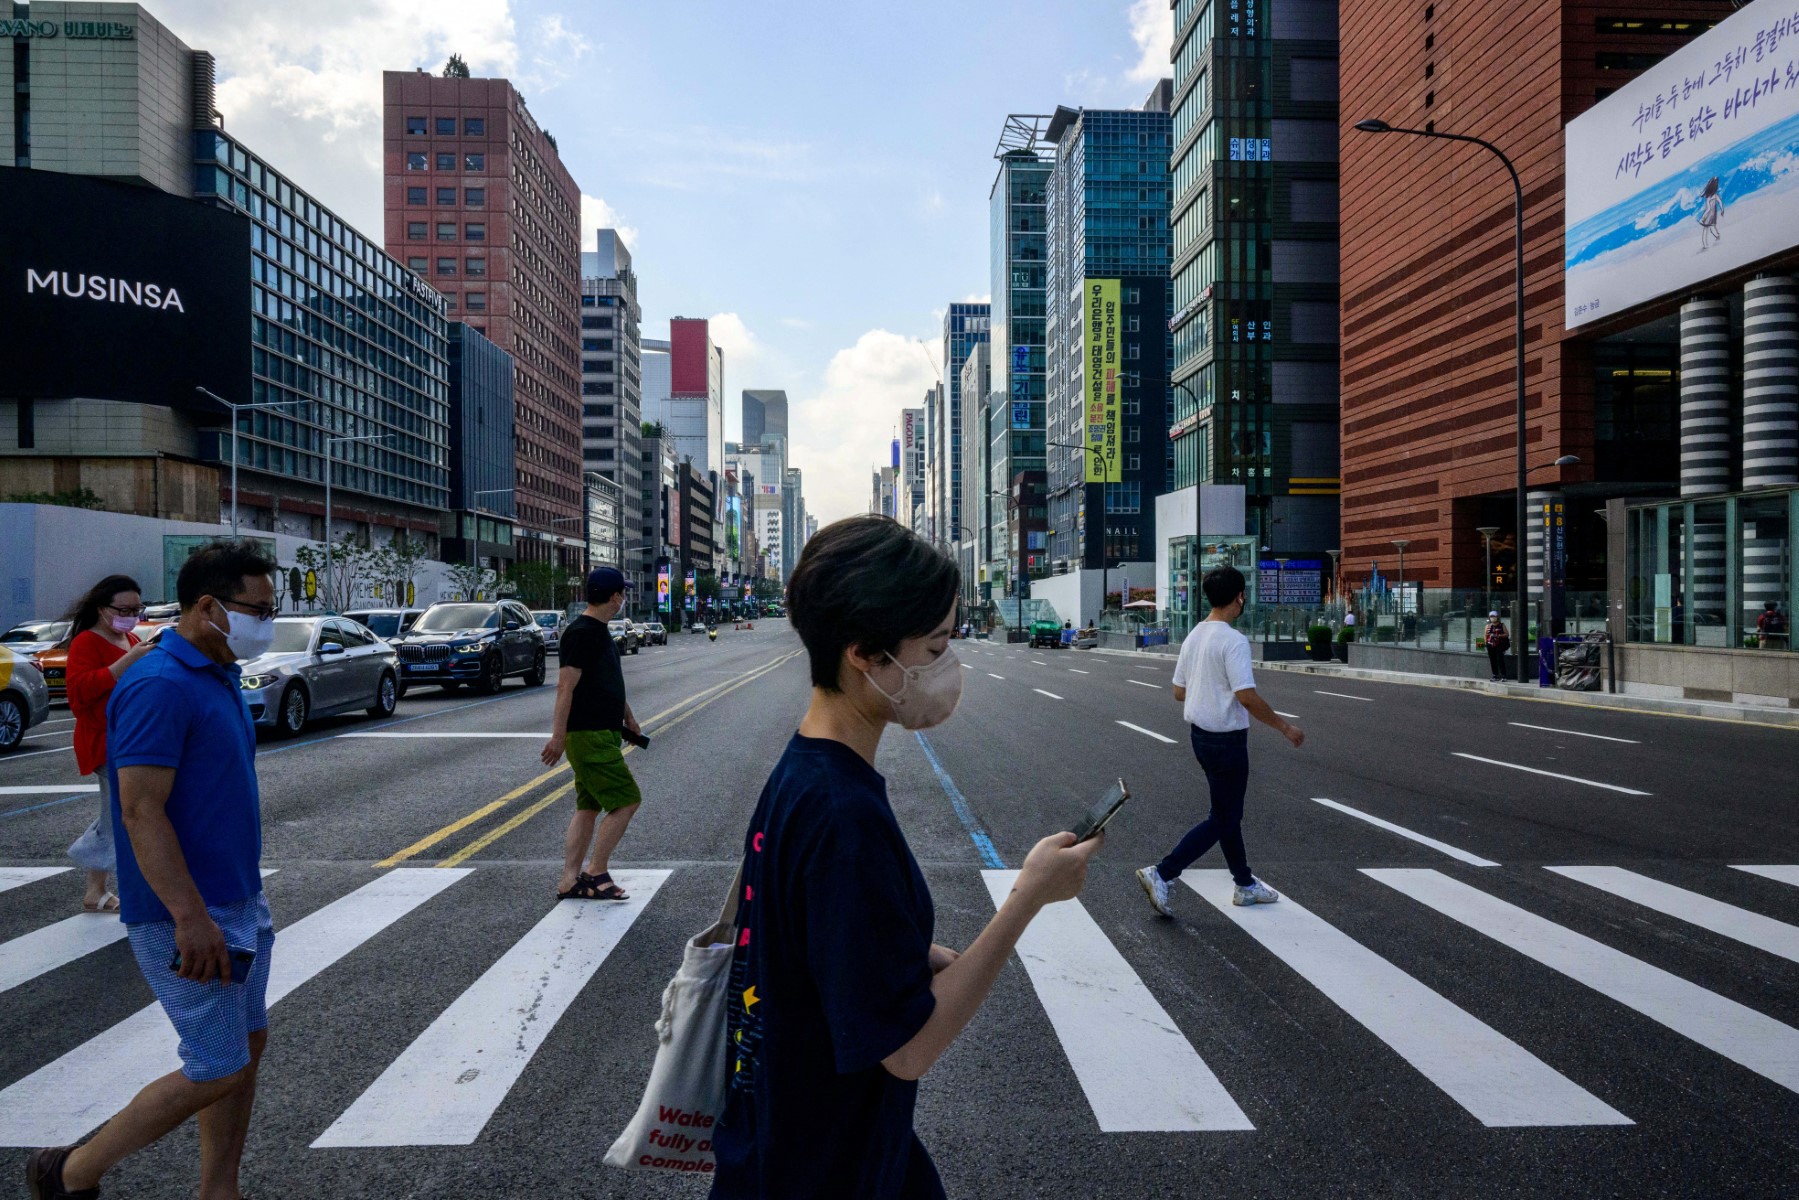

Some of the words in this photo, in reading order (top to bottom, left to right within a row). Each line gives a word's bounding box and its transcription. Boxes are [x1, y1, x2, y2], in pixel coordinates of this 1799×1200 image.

[64, 21, 132, 39] 비제바노
[1632, 94, 1664, 134] 우리들
[1666, 84, 1679, 109] 두
[1682, 69, 1705, 101] 눈에
[1708, 45, 1747, 86] 그득히
[1615, 141, 1654, 180] 시작도
[1657, 123, 1684, 159] 끝도
[1689, 105, 1717, 142] 없는
[1724, 66, 1780, 120] 바다가
[26, 267, 186, 314] MUSINSA
[1091, 284, 1103, 342] 우리은행과
[1105, 301, 1115, 364] 입주민들의
[905, 413, 914, 449] PAGODA
[1106, 526, 1138, 536] NAIL
[1496, 576, 1503, 584] R
[658, 1105, 716, 1129] Wake
[648, 1128, 696, 1154] fully
[697, 1139, 715, 1153] a
[638, 1154, 716, 1173] comple
